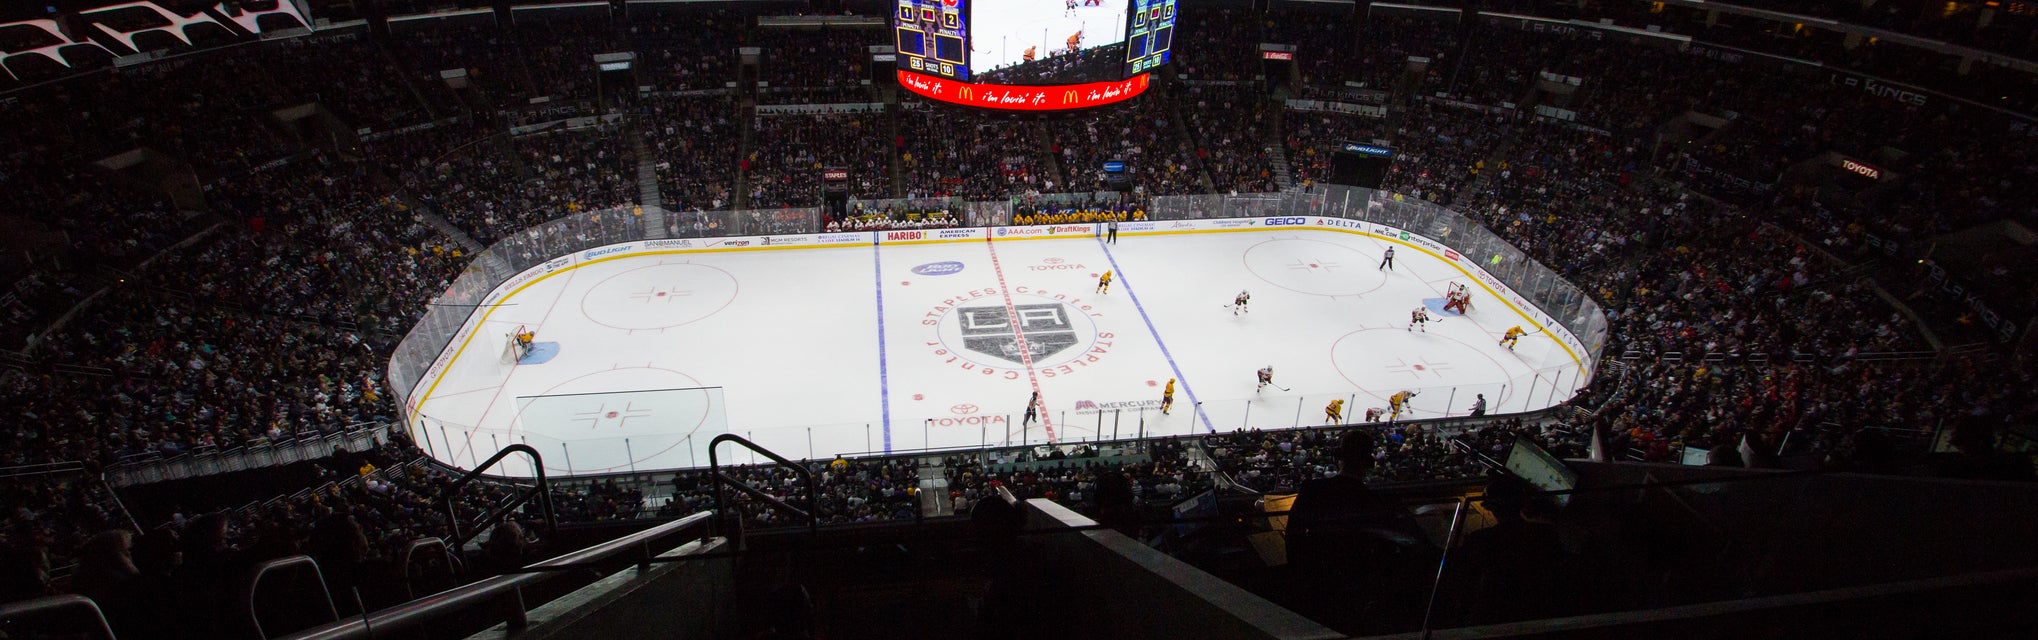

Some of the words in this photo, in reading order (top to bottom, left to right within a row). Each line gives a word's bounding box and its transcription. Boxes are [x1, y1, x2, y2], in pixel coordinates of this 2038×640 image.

[904, 8, 909, 17] 1
[949, 15, 955, 24] 2
[912, 59, 921, 67] 25
[942, 65, 951, 73] 10
[982, 91, 998, 103] i'm
[1000, 91, 1029, 104] lovin'
[1087, 90, 1101, 101] i'm
[1102, 84, 1123, 100] lovin'
[1843, 160, 1878, 179] TOYOTA
[1265, 217, 1306, 226] GEICO
[1327, 219, 1361, 229] DELTA
[1008, 228, 1042, 236] AAA.com
[1056, 225, 1090, 233] DraftKings
[888, 231, 921, 240] HARIBO
[724, 239, 750, 248] verizon
[588, 249, 606, 258] BUD
[607, 245, 632, 255] LIGHT
[1027, 264, 1086, 272] TOYOTA
[1485, 276, 1507, 295] TOYOTA
[922, 287, 997, 327] STAPLES
[1016, 286, 1103, 318] Center
[436, 346, 455, 368] TOYOTA
[926, 341, 1019, 380] Center
[1041, 331, 1115, 378] STAPLES
[929, 415, 1006, 427] TOYOTA
